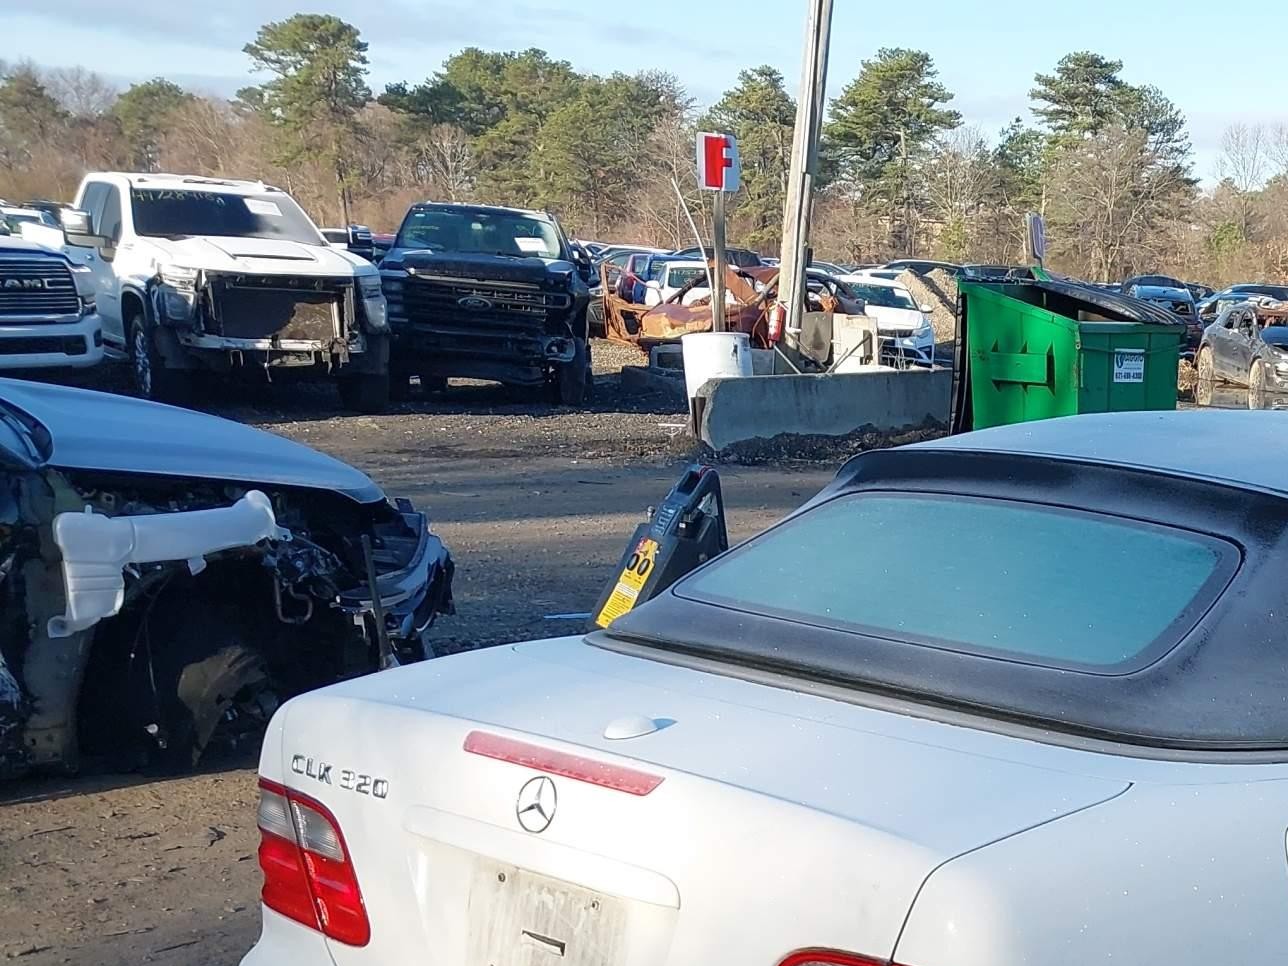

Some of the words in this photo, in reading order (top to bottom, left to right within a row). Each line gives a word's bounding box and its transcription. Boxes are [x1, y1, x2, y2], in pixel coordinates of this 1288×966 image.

[704, 135, 732, 188] F
[0, 279, 42, 288] AM
[291, 754, 332, 785] CLK
[340, 769, 389, 799] 320
